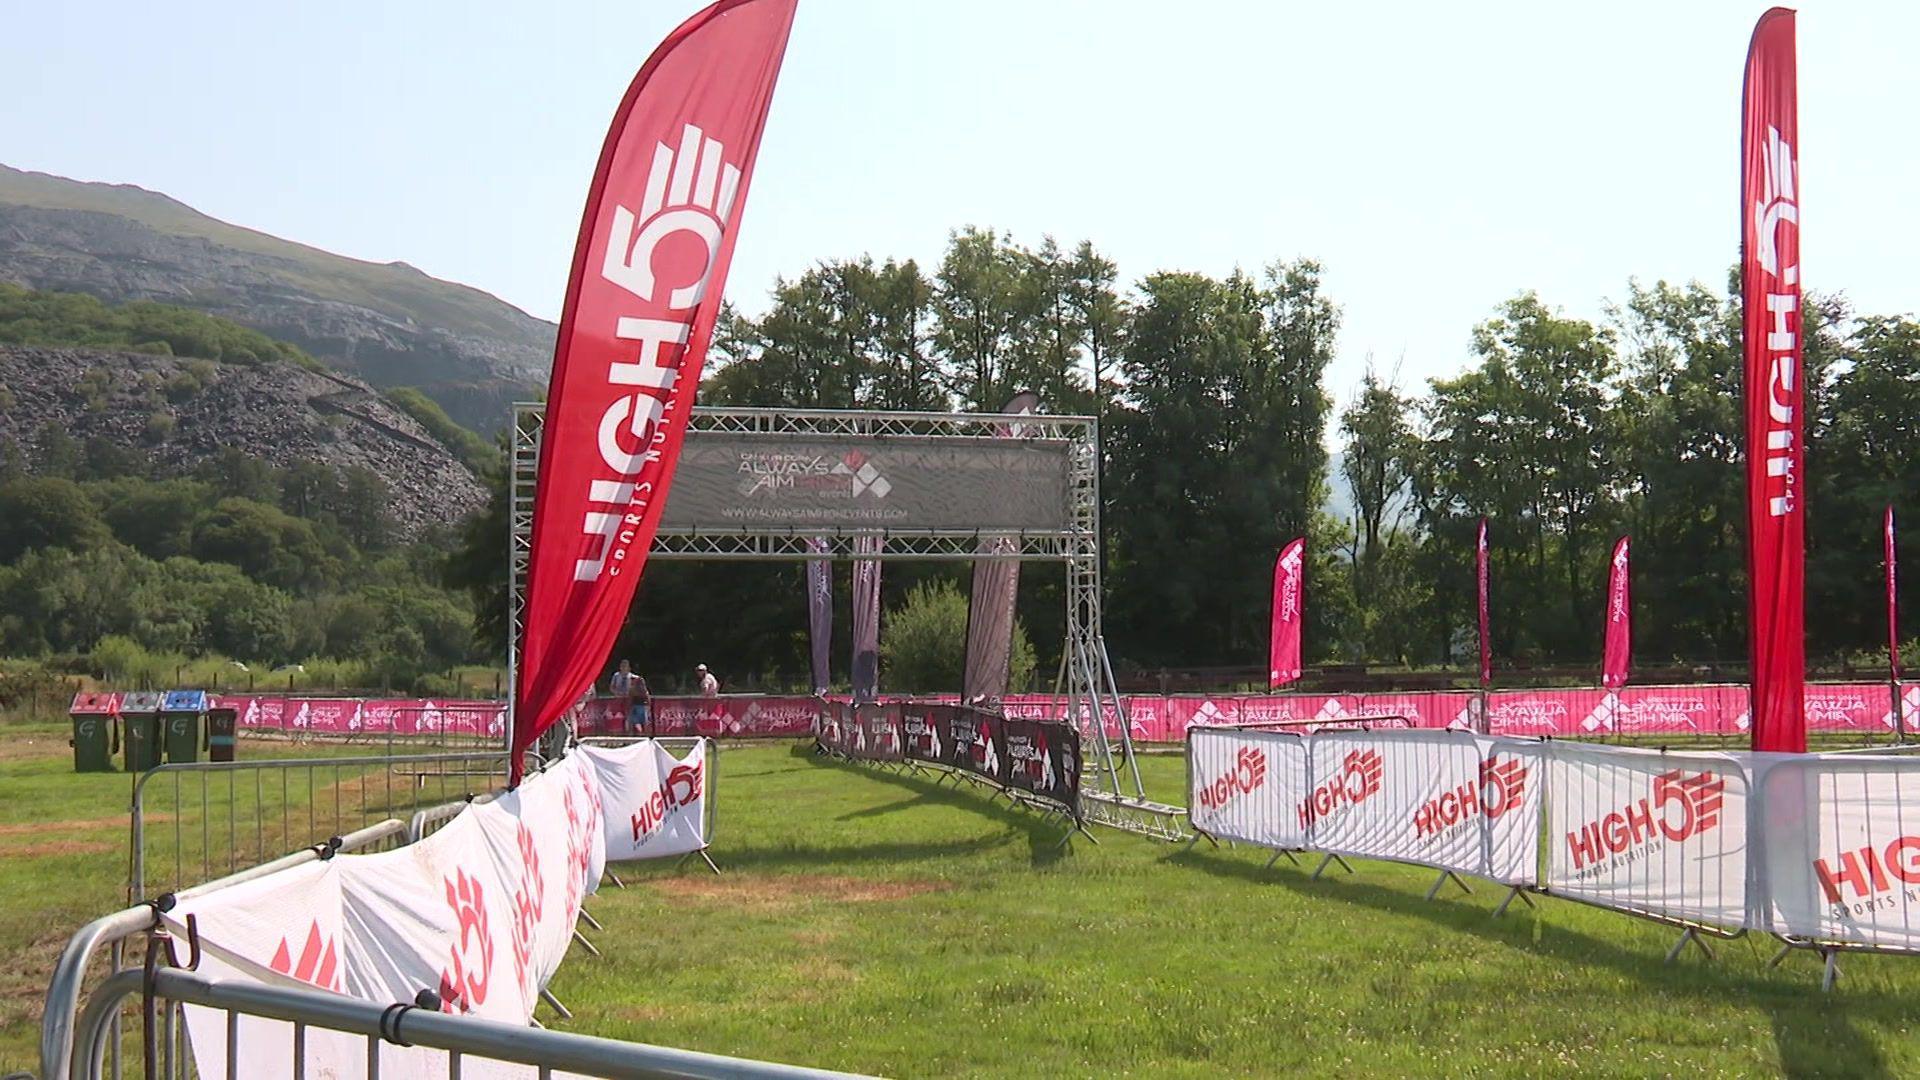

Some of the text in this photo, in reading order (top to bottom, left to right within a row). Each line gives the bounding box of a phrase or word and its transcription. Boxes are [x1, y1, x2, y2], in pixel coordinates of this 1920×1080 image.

[737, 455, 829, 476] ALWAYS
[748, 474, 795, 496] AIM
[631, 759, 702, 842] HIGH5
[1297, 749, 1383, 831] HIGH5
[1567, 768, 1724, 869] HIGH5
[1832, 895, 1896, 921] SPORTS
